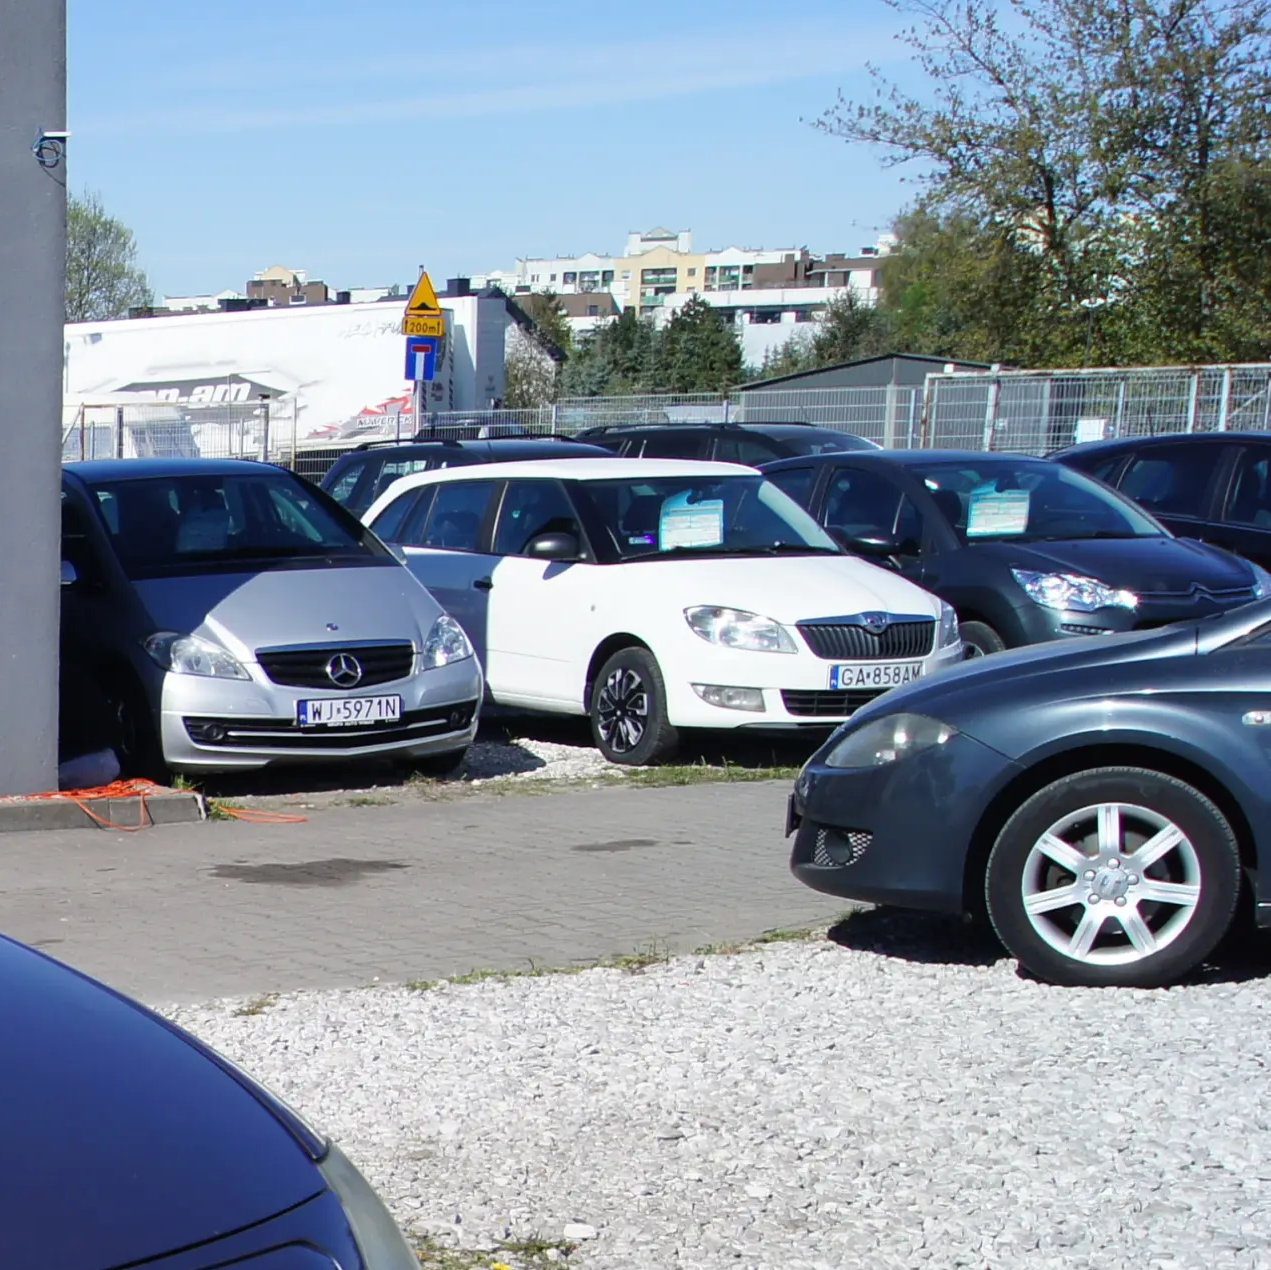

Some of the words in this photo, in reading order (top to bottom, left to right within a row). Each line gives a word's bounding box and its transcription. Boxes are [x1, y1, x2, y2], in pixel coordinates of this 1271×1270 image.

[841, 668, 865, 686] GA
[312, 702, 334, 721] WJ
[343, 698, 396, 719] 5971N
